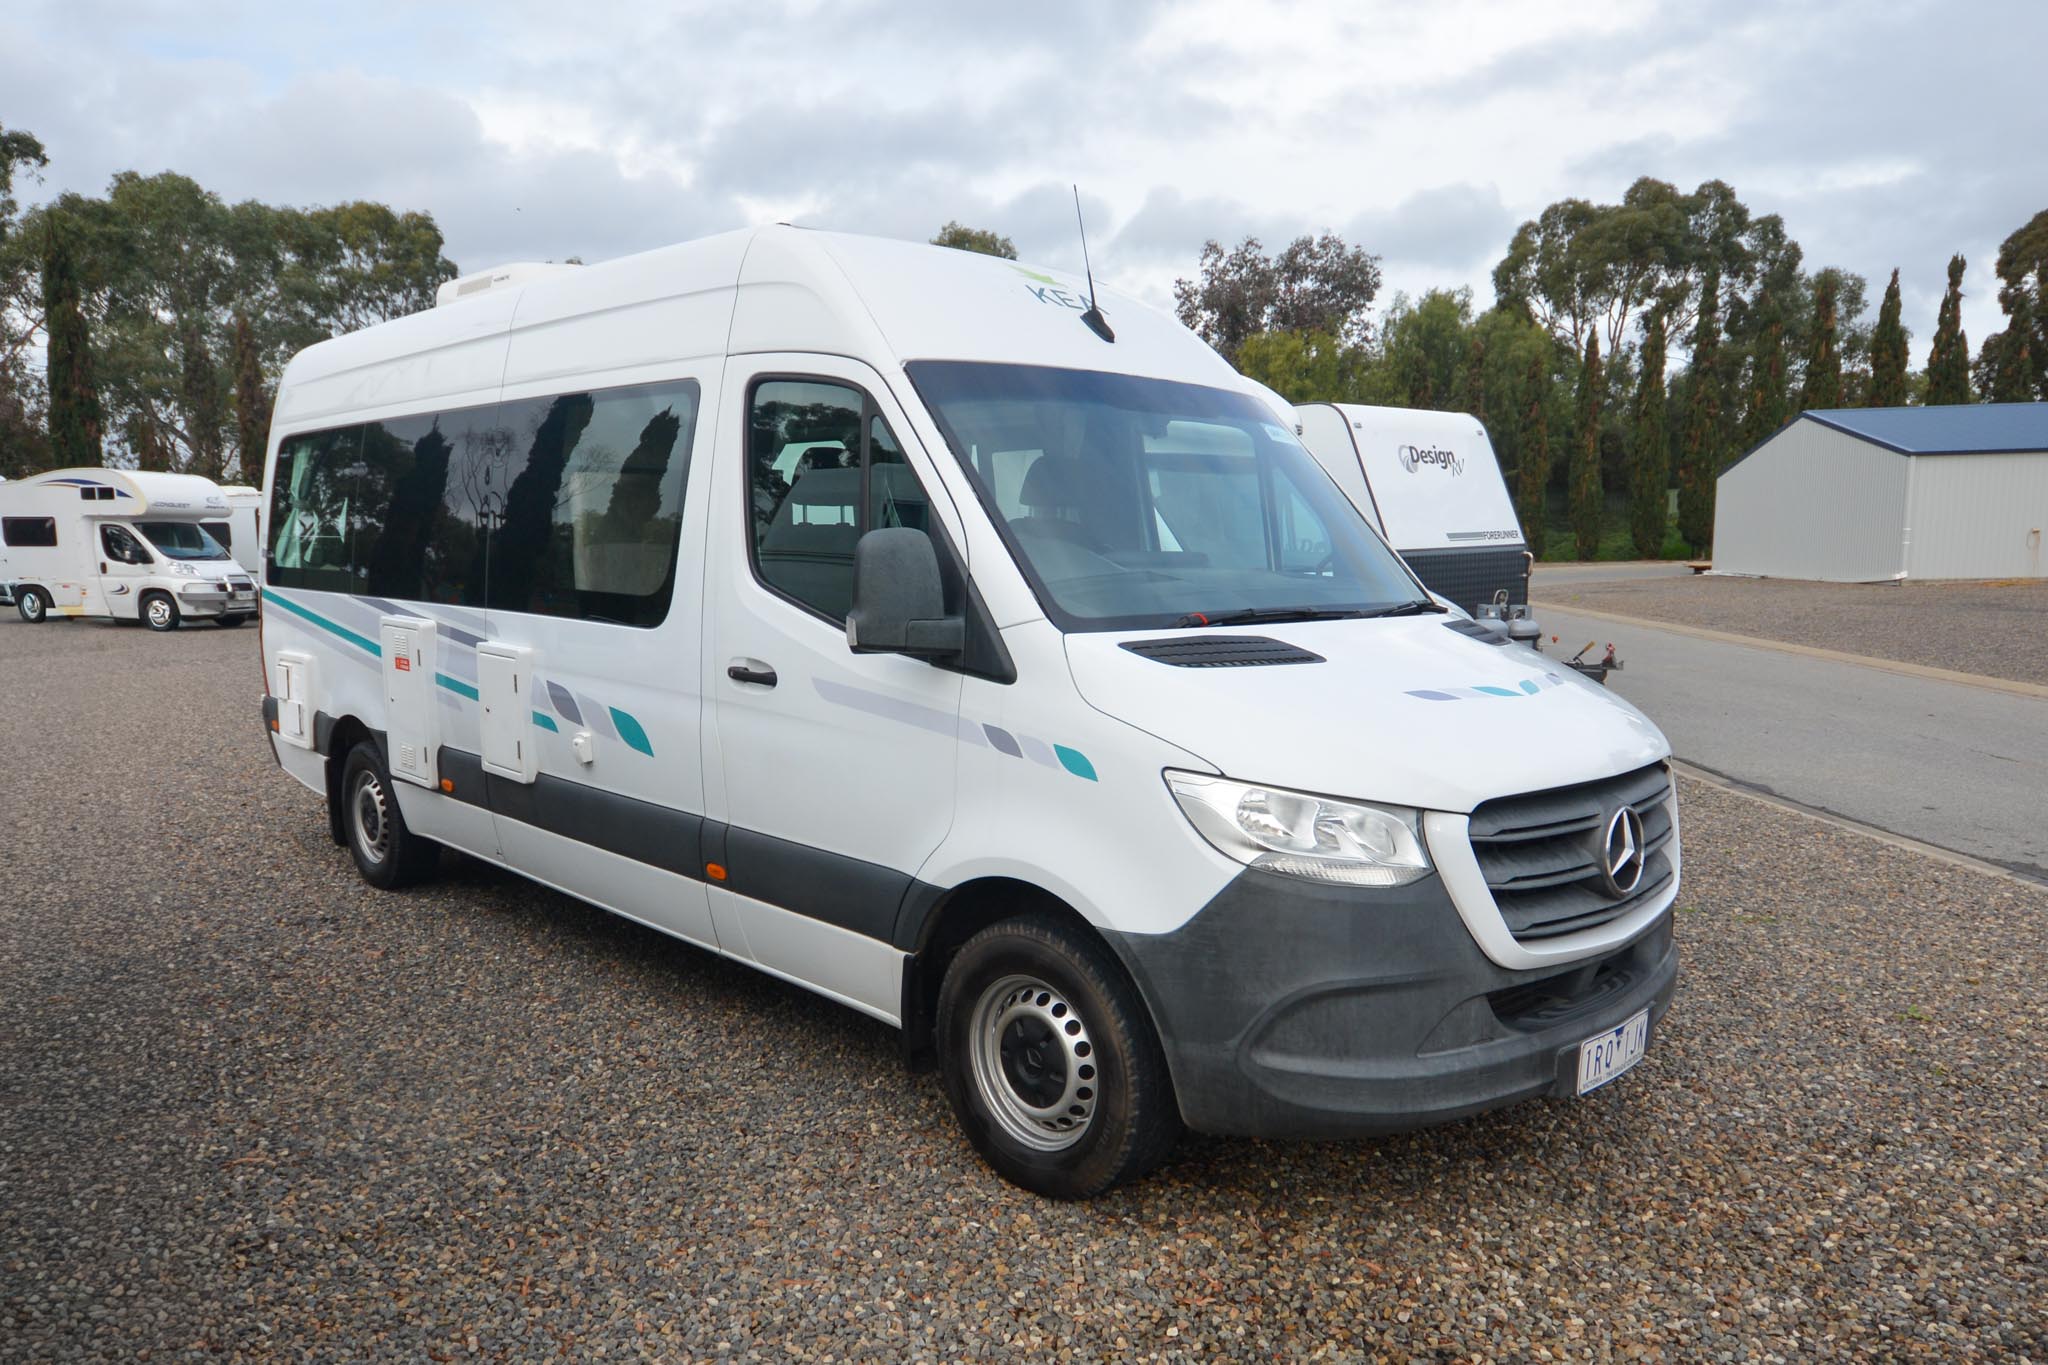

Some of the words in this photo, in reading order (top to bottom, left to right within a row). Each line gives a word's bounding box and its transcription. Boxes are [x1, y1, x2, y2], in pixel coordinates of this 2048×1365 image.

[1408, 445, 1456, 470] Design
[1450, 458, 1465, 478] RV
[1482, 530, 1519, 540] FORERUNNER
